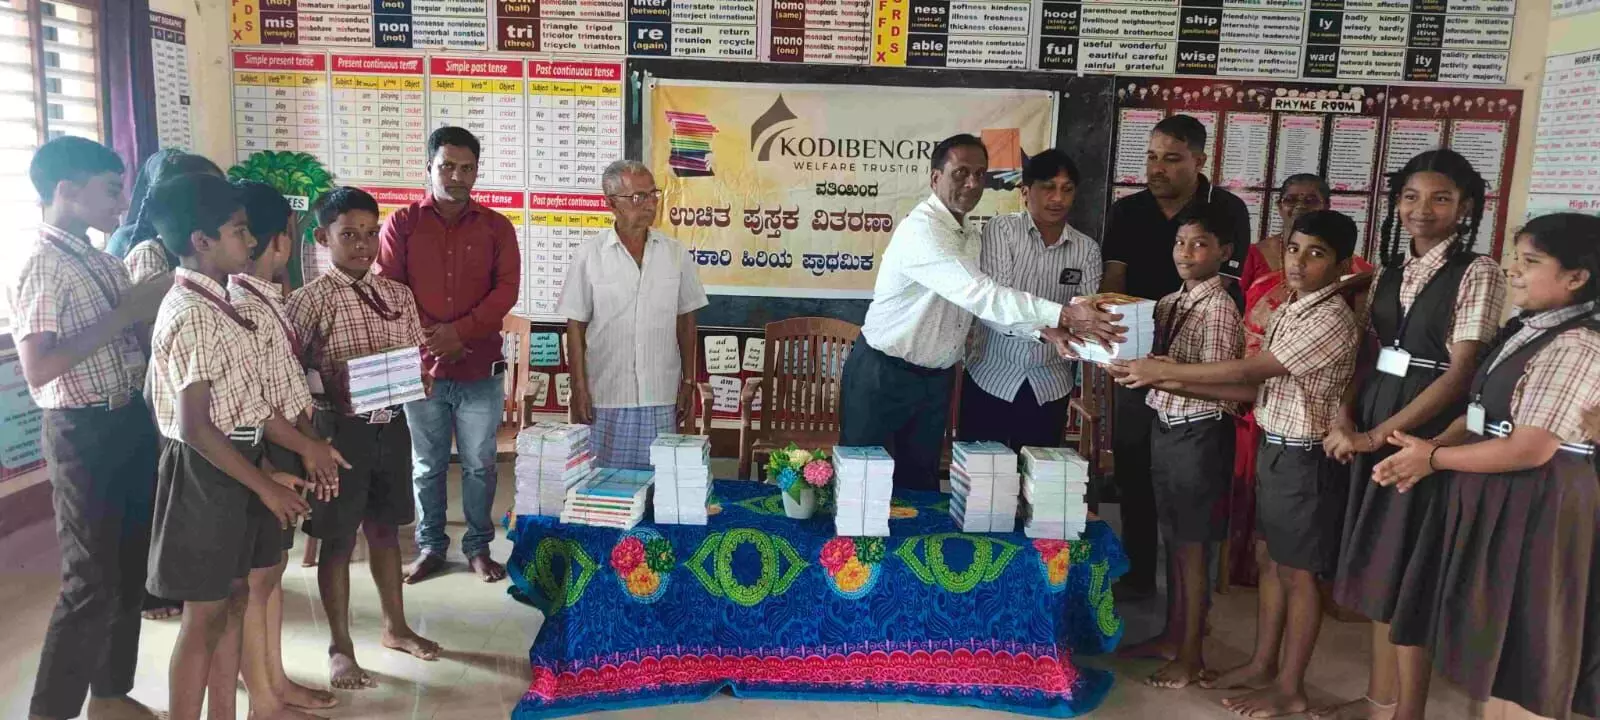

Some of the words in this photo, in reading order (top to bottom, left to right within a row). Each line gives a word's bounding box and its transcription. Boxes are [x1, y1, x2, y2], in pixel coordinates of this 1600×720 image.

[338, 2, 371, 10] impartial
[382, 1, 404, 9] (not)
[413, 5, 441, 13] irregular
[446, 5, 485, 13] irreplaceable
[505, 5, 530, 13] (half)
[673, 2, 715, 10] interstate
[719, 4, 754, 12] interlock
[774, 0, 804, 10] homo
[915, 6, 946, 14] ness
[630, 7, 671, 16] (between)
[673, 12, 707, 20] interject
[775, 11, 802, 20] (same)
[1044, 9, 1077, 19] hood
[265, 17, 295, 28] mis
[329, 16, 369, 24] misconduct
[1121, 18, 1175, 26] neighbourhood
[1186, 15, 1218, 26] ship
[1319, 18, 1334, 30] ly
[380, 23, 409, 32] non
[506, 25, 533, 38] tri
[543, 23, 578, 31] triangle
[719, 28, 750, 36] return
[1082, 27, 1119, 35] childhood
[1123, 28, 1174, 37] brotherhood
[413, 29, 450, 37] nonverbal
[578, 33, 623, 41] trimesters
[638, 28, 664, 40] re
[383, 34, 406, 43] (not)
[773, 36, 803, 46] mono
[504, 40, 535, 49] (three)
[544, 41, 577, 49] tricycle
[633, 41, 668, 51] (again)
[912, 40, 944, 51] able
[1046, 43, 1073, 56] ful
[1083, 40, 1113, 48] useful
[1119, 42, 1167, 50] wonderful
[777, 47, 799, 55] (one)
[1180, 51, 1216, 61] wise
[1221, 46, 1260, 54] otherwise
[1264, 48, 1297, 56] likewise
[1471, 52, 1507, 60] electricity
[244, 54, 268, 67] Simple
[269, 56, 294, 67] present
[295, 57, 315, 67] tense
[1131, 53, 1168, 61] careful
[1309, 52, 1337, 61] ward
[1415, 54, 1433, 67] ity
[1574, 55, 1591, 65] HIGH
[337, 57, 362, 68] Present
[363, 58, 399, 69] continuous
[399, 60, 418, 70] tense
[445, 60, 469, 74] Simple
[470, 62, 487, 74] past
[488, 63, 508, 73] tense
[1125, 63, 1165, 71] grateful
[535, 63, 552, 75] Past
[552, 64, 593, 77] continuous
[594, 66, 615, 77] tense
[436, 80, 454, 89] Subject
[498, 82, 516, 91] Object
[577, 99, 595, 107] playing
[1275, 99, 1317, 110] RHYME
[1321, 101, 1355, 112] ROOM
[577, 112, 595, 120] playing
[577, 124, 595, 133] playing
[793, 161, 856, 172] WELFARE
[816, 180, 879, 197] ವತಿಯಿಂದ
[378, 190, 409, 201] continuous
[409, 193, 425, 201] tense
[491, 194, 513, 204] tense
[533, 194, 546, 205] Past
[546, 196, 567, 208] perfect
[567, 197, 600, 208] continuous
[1568, 199, 1589, 210] High
[669, 202, 731, 228] ಉಚಿತ
[743, 203, 800, 239] ಪುಸ್ತಕ
[811, 205, 894, 233] ವಿತರಣಾ
[742, 250, 793, 269] ಹಿರಿಯ
[802, 251, 874, 276] ಪ್ರಾಥಮಿಕ
